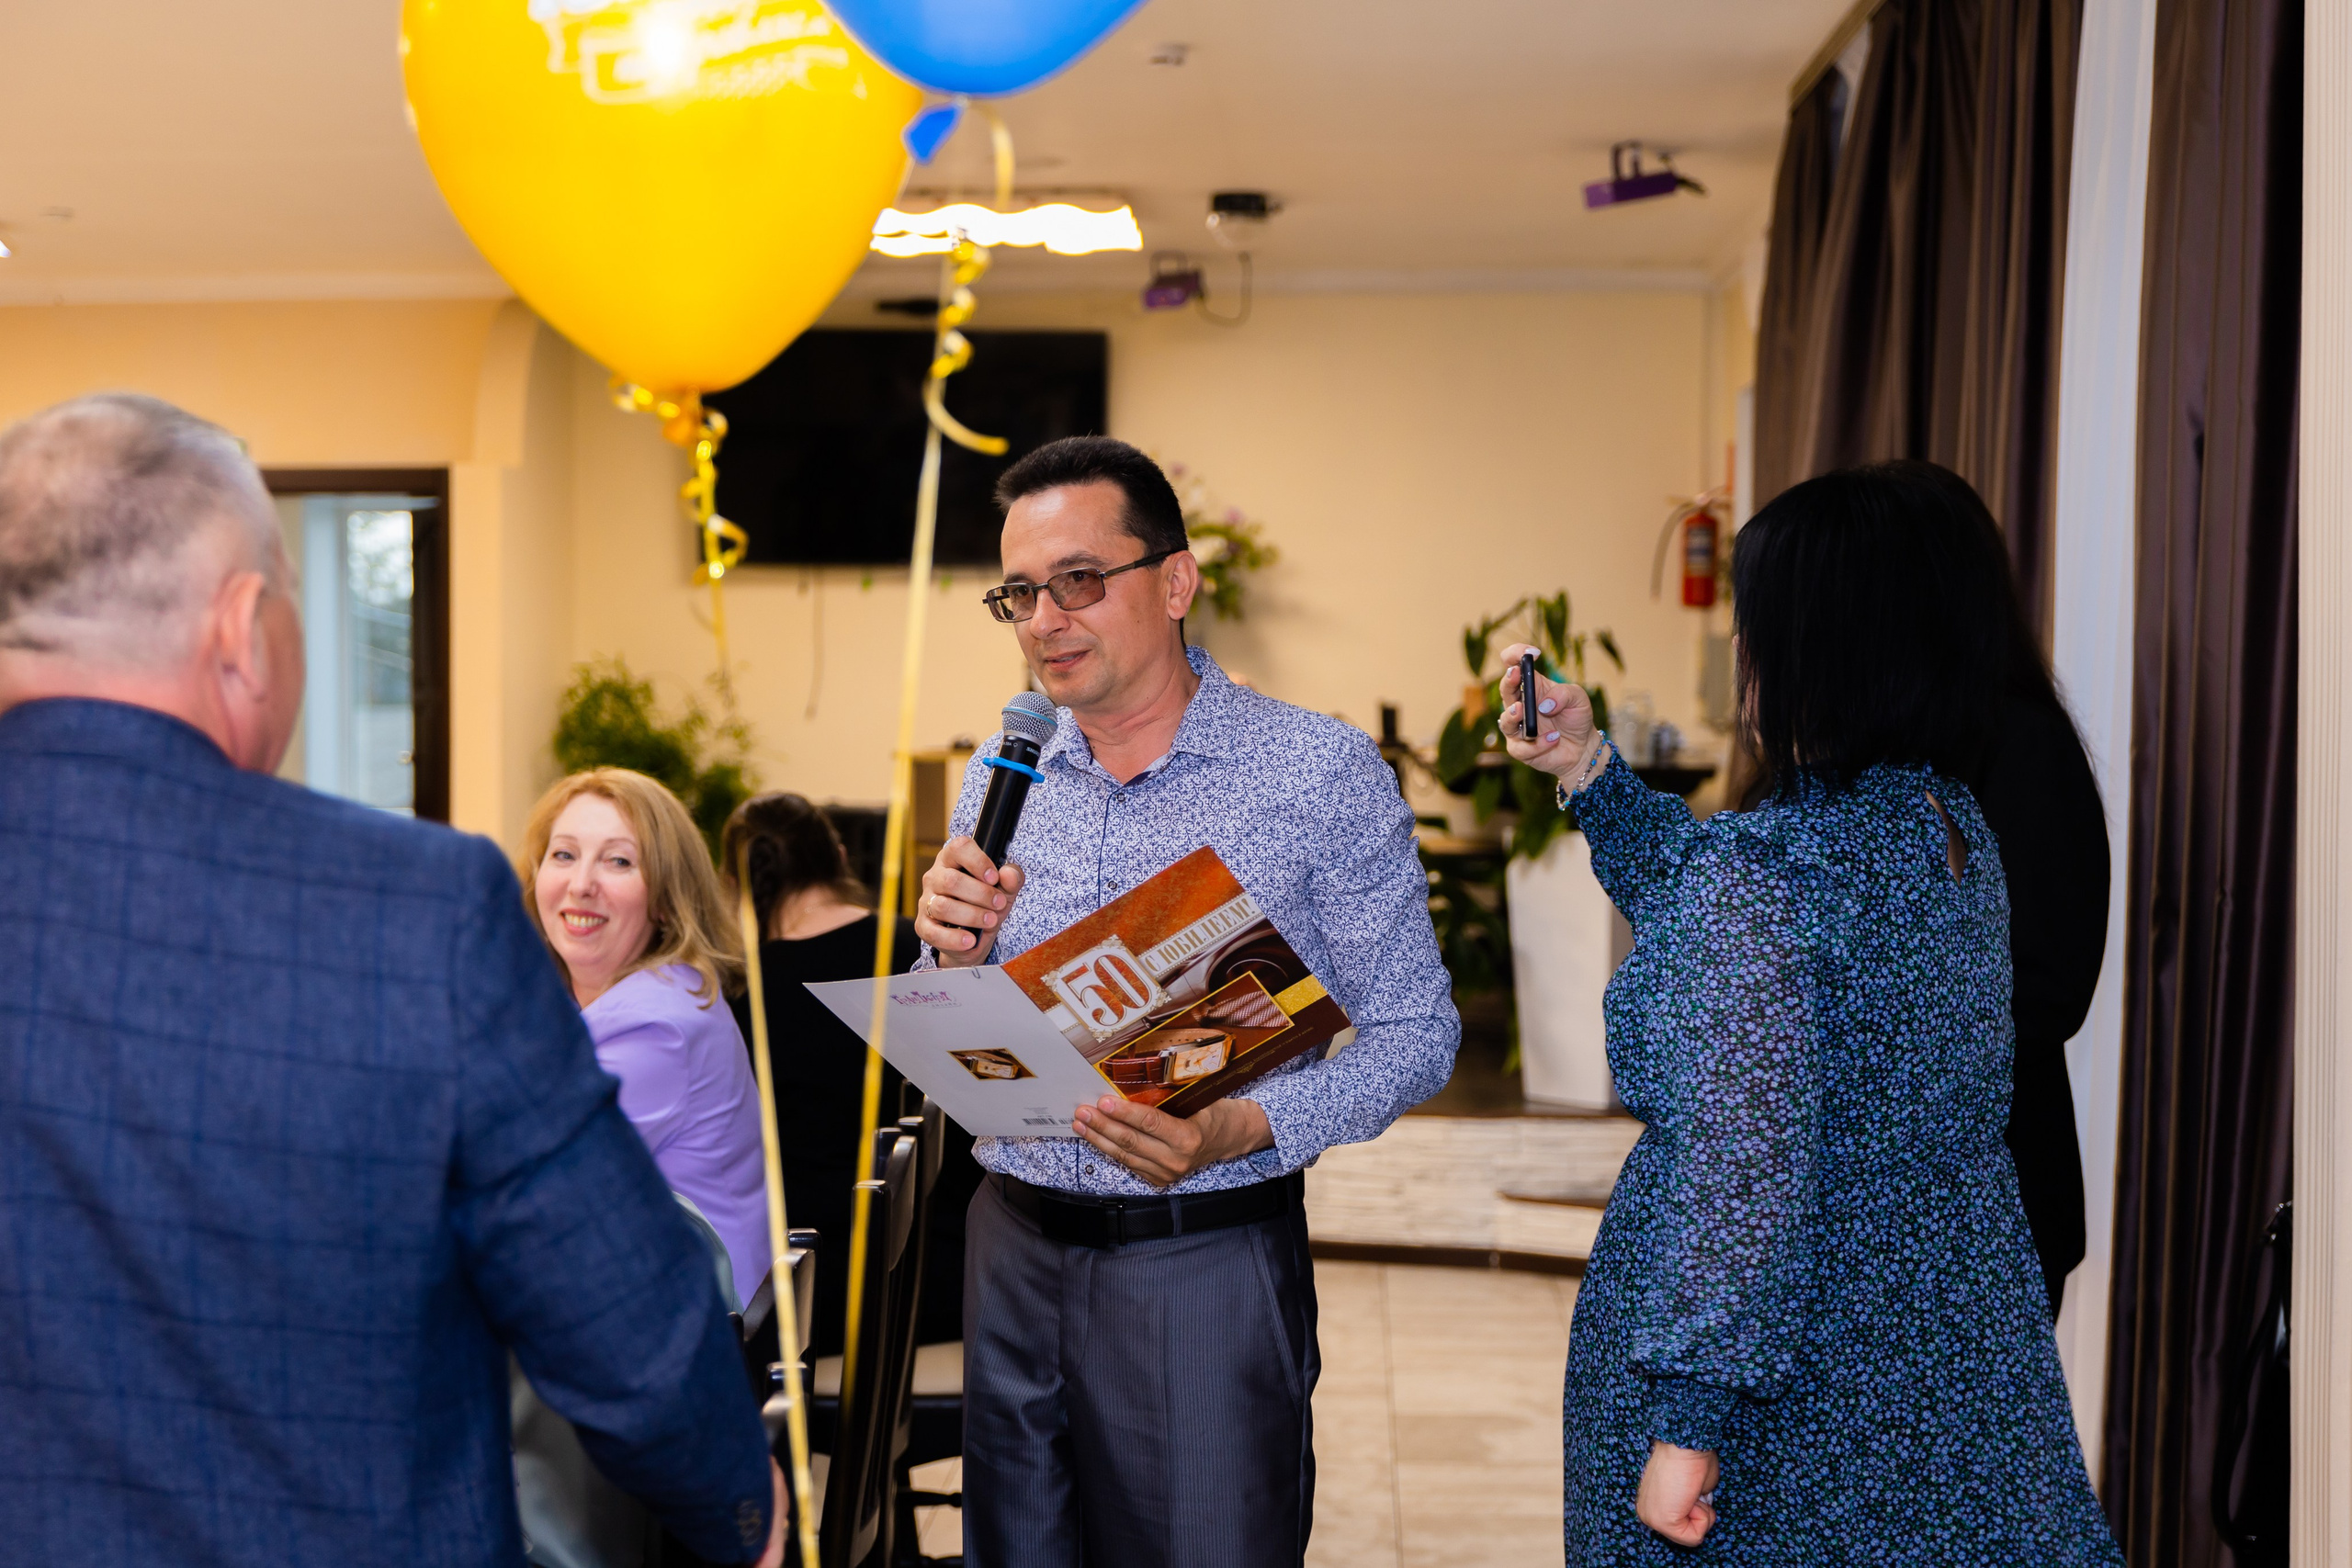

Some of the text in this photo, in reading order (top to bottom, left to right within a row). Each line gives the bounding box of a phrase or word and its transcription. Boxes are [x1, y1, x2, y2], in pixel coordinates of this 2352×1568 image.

[1145, 897, 1256, 972] С ЮБИЛЕЕМ!
[1061, 953, 1152, 1027] 50
